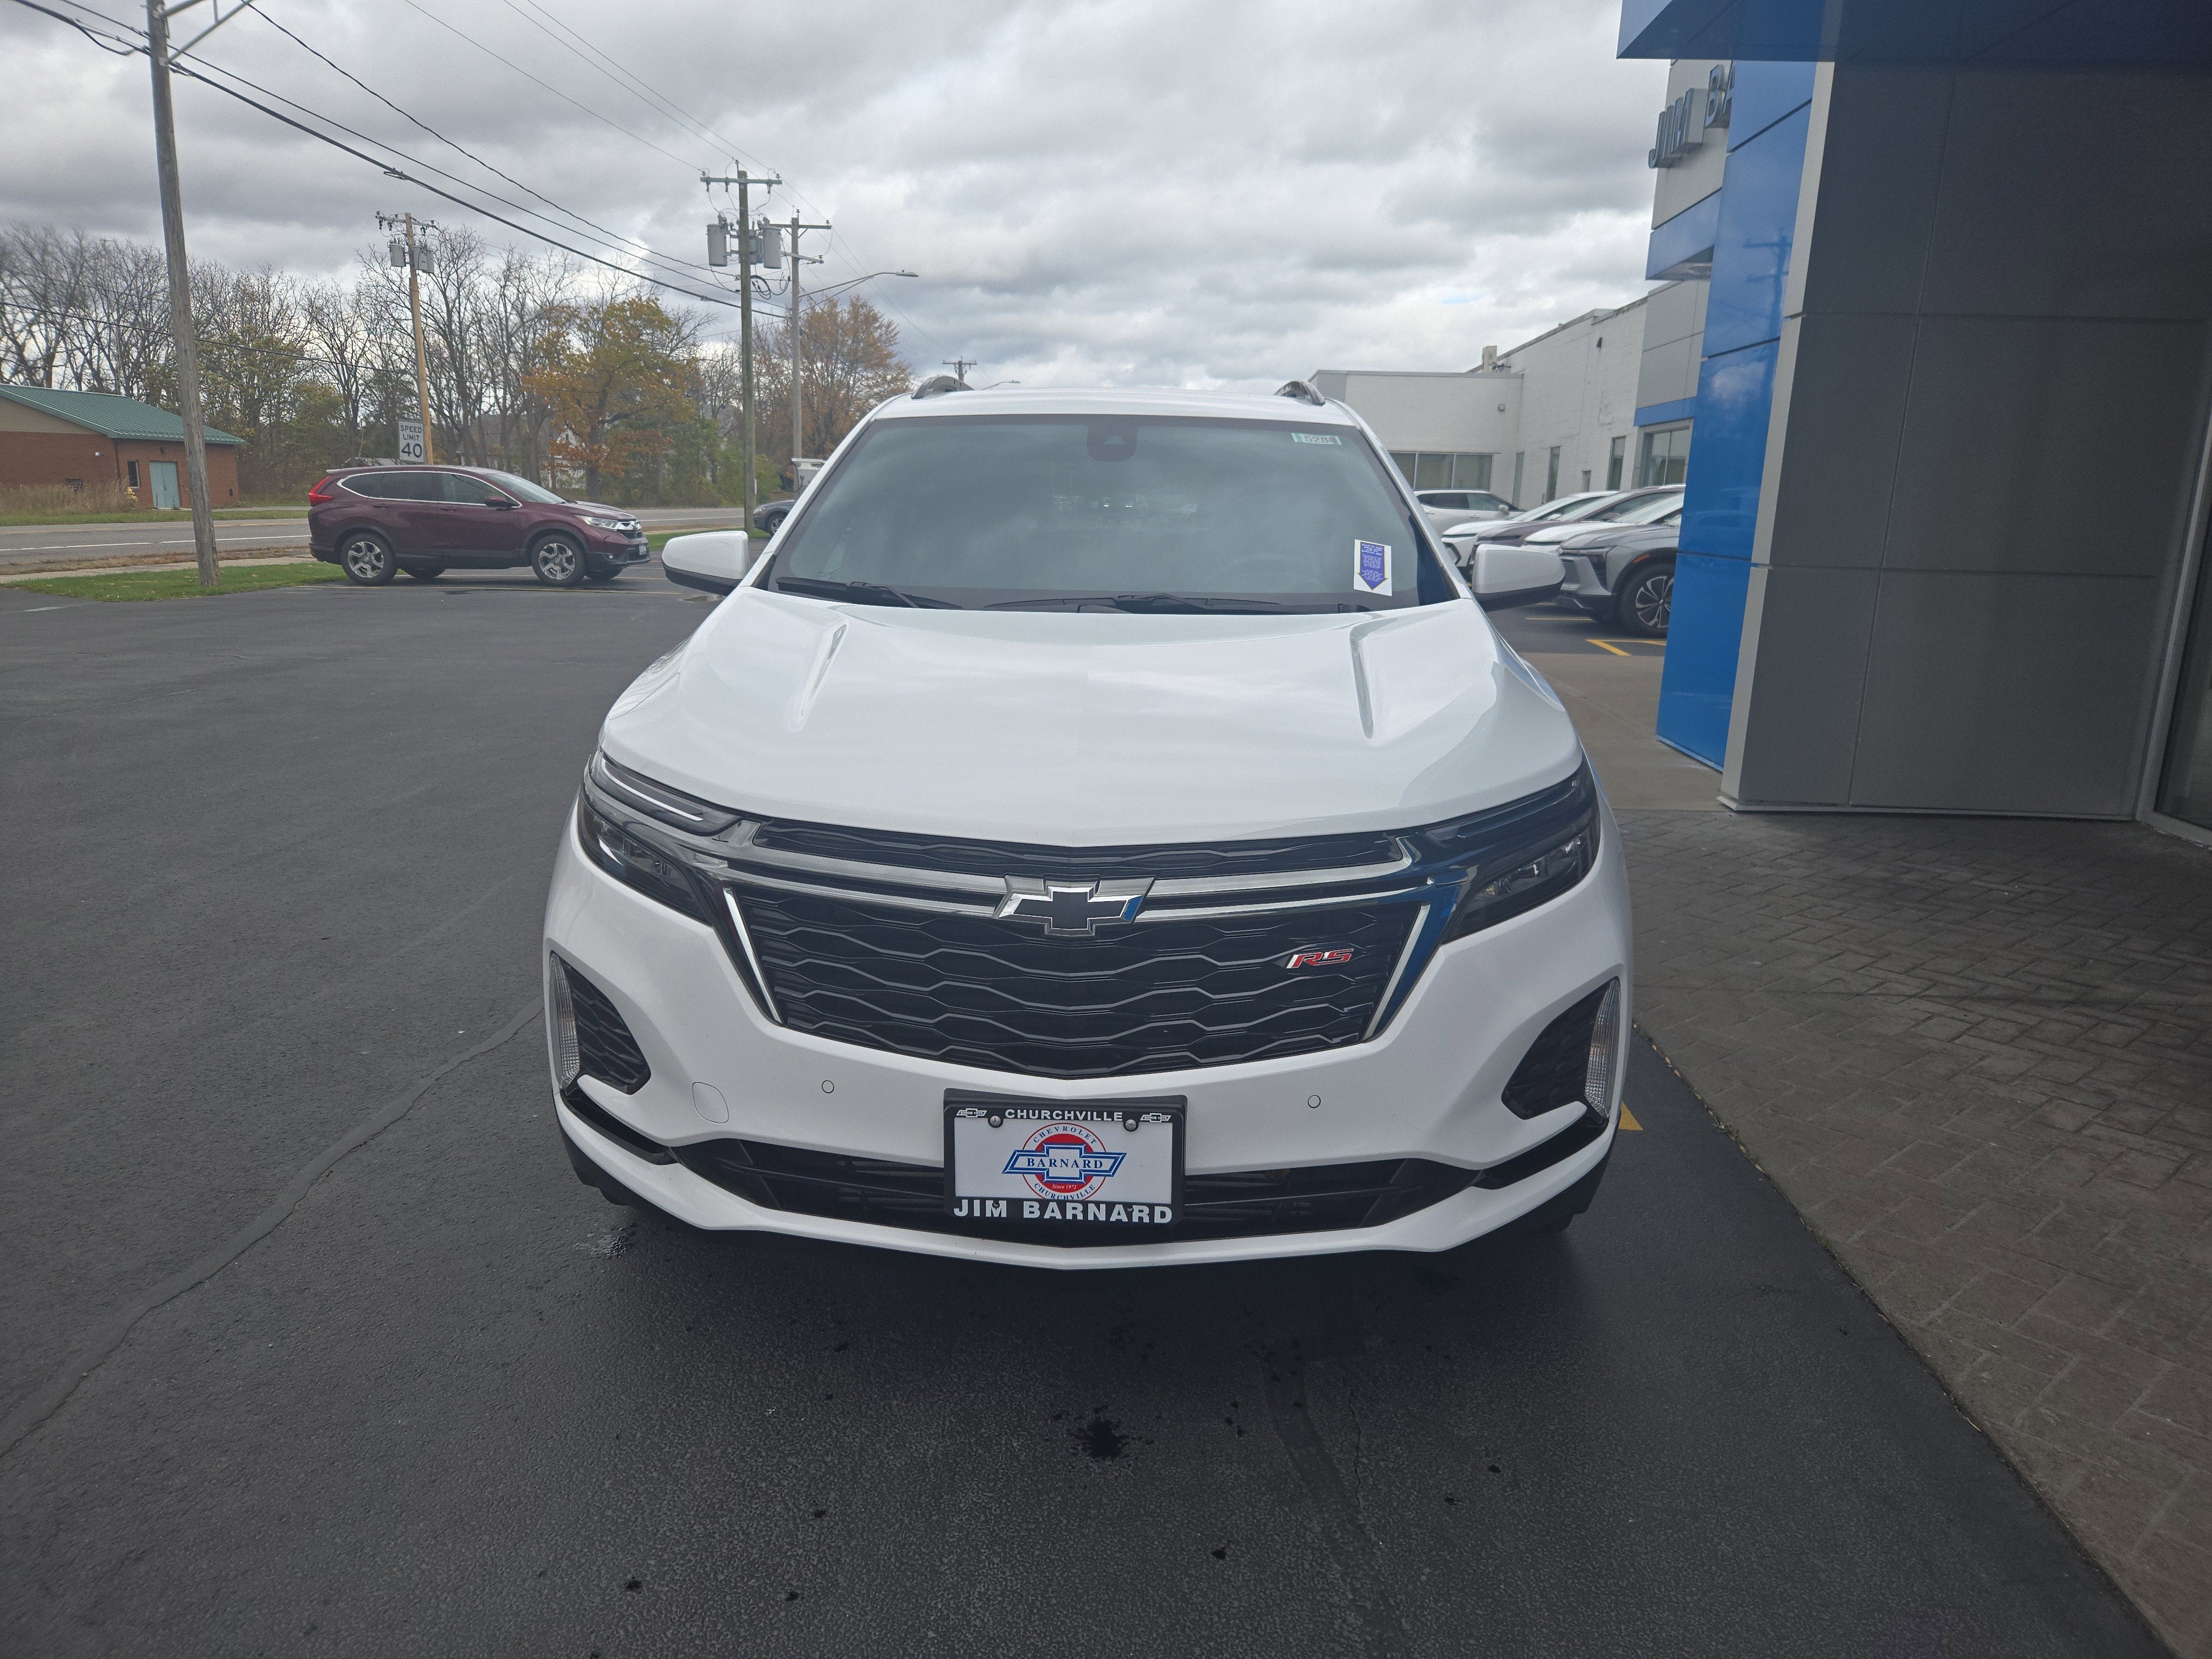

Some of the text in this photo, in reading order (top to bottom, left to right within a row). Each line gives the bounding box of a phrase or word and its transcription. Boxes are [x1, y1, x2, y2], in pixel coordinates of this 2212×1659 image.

[1648, 88, 1694, 169] JIM
[401, 425, 422, 433] SPEED
[401, 442, 422, 458] 40
[1286, 948, 1354, 968] RS
[1005, 1109, 1123, 1121] CHURCHVILLE
[1033, 1126, 1097, 1144] CHEVROLET
[1026, 1158, 1103, 1169] BARNARD
[1034, 1183, 1096, 1200] CHURCHVILLE
[954, 1199, 1172, 1223] JIM BARNARD
